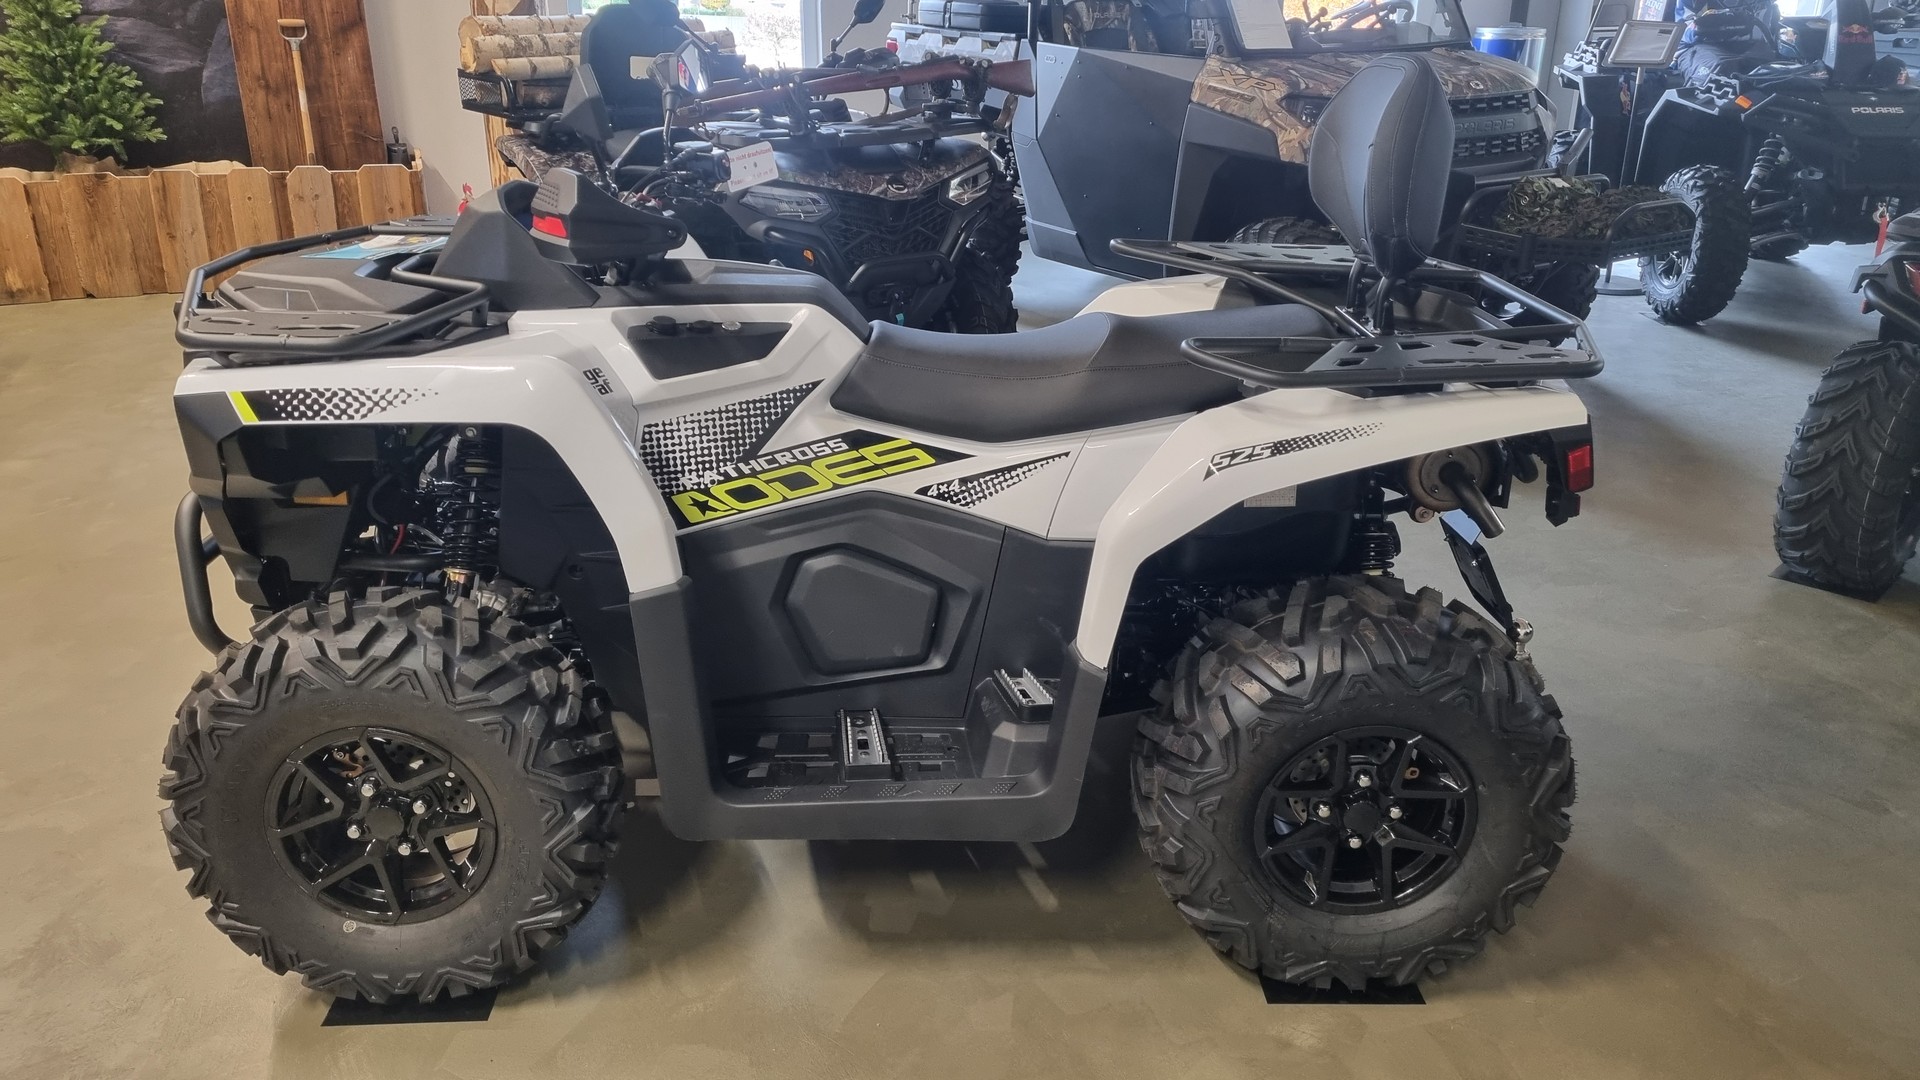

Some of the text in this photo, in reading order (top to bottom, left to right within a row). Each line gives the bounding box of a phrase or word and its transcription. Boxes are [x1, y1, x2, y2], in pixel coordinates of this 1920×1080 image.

[1851, 106, 1905, 114] POLARIS
[1212, 442, 1274, 469] 525
[926, 478, 960, 497] 4x4
